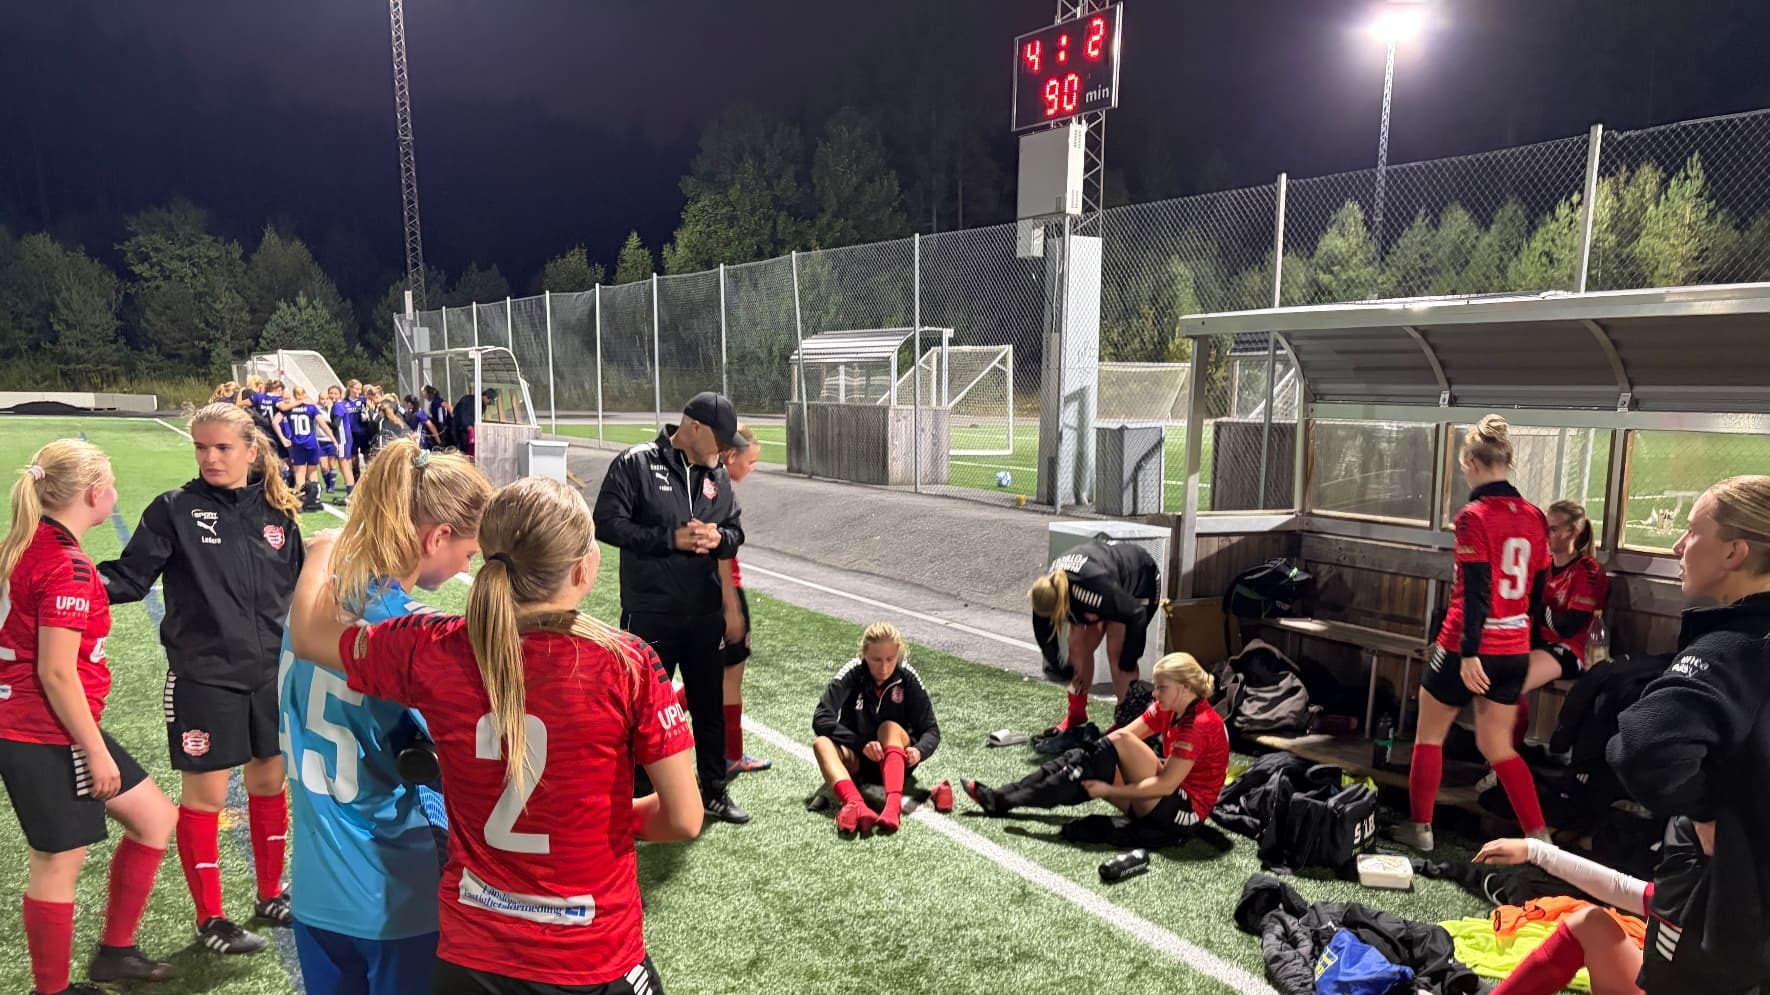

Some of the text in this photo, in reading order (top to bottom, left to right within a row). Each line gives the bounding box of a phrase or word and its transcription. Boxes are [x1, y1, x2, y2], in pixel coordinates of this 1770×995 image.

[1026, 40, 1041, 71] 4
[1087, 18, 1104, 57] 2
[1046, 74, 1110, 116] 90 min
[290, 414, 311, 436] 10
[1498, 537, 1531, 600] 9
[475, 712, 550, 855] 2
